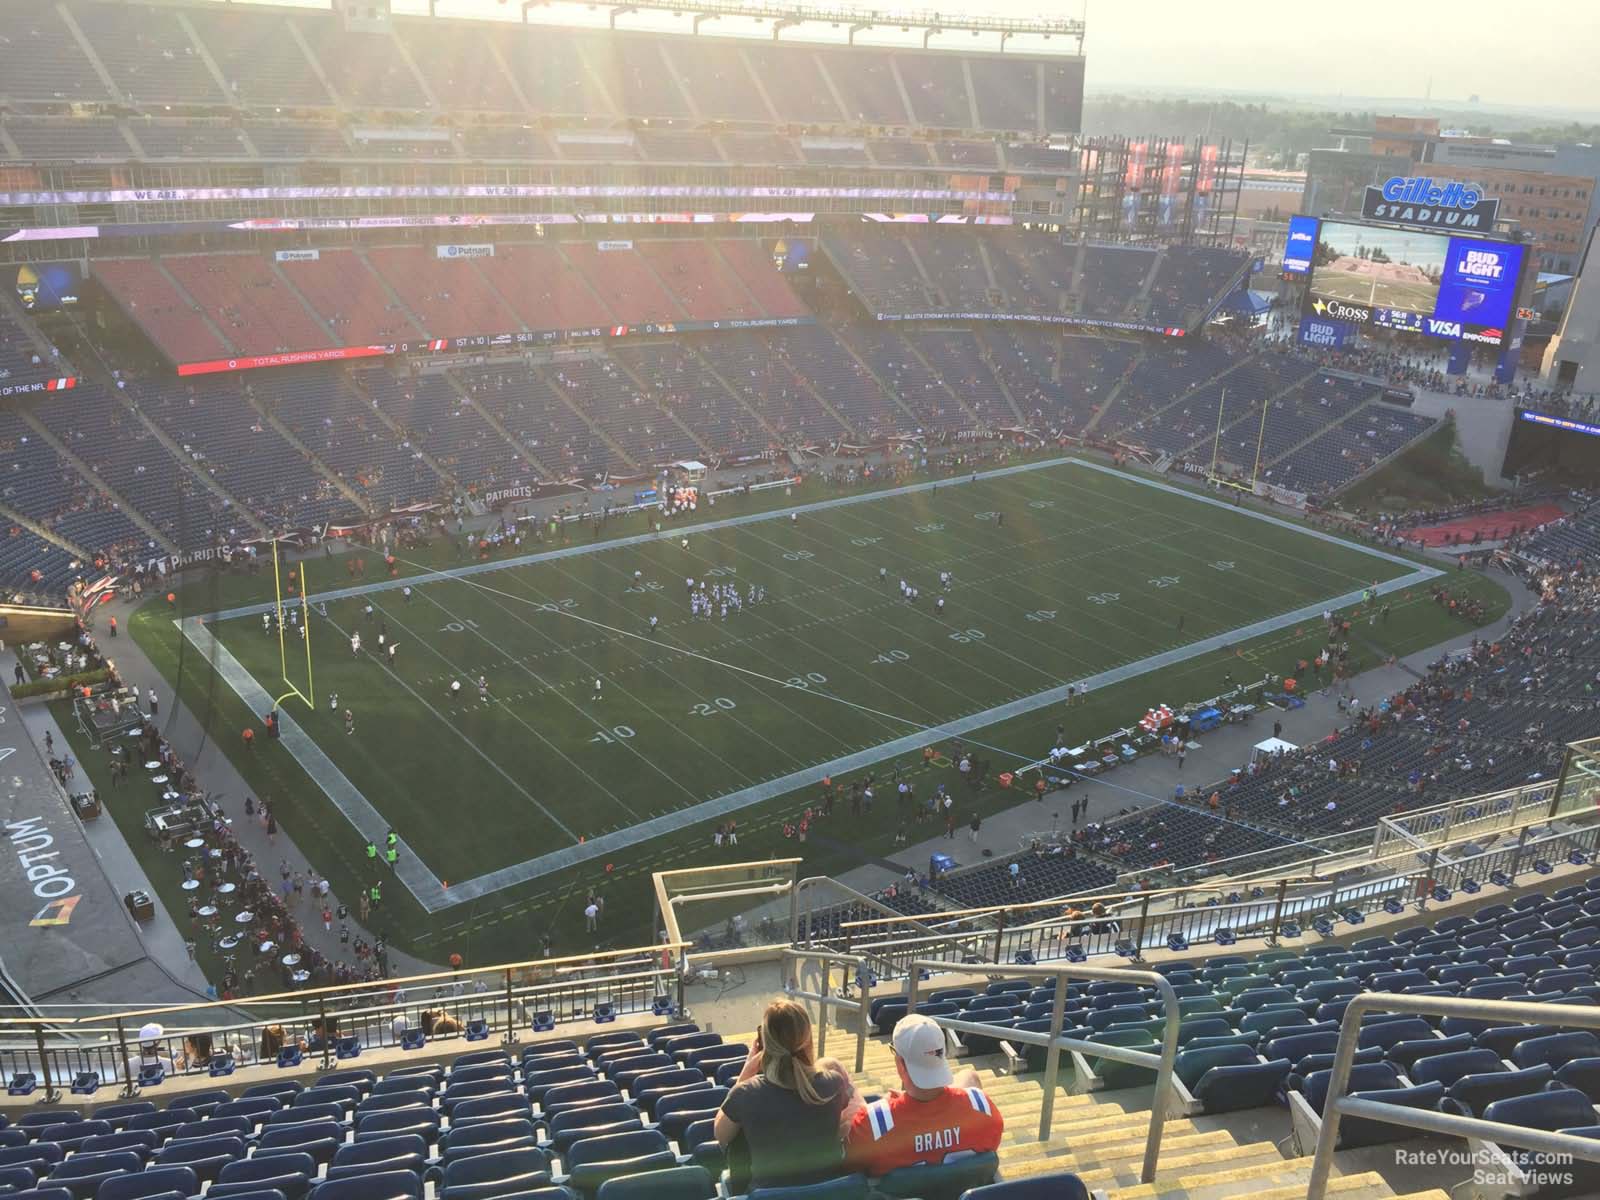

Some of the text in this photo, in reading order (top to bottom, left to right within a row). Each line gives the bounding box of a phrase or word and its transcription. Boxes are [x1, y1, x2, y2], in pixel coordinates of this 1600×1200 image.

[1382, 176, 1480, 210] Gillette
[1374, 204, 1481, 227] STADIUM
[459, 247, 490, 257] Putnam
[1467, 250, 1499, 265] BUD
[1458, 261, 1502, 278] LIGHT
[591, 328, 601, 337] 45
[1310, 323, 1334, 336] BUD
[1428, 319, 1461, 337] VISA
[1304, 332, 1336, 345] LIGHT
[1462, 332, 1502, 345] EMPOWER
[253, 357, 280, 366] TOTAL
[281, 353, 317, 363] RUSHING
[318, 350, 345, 360] YARDS
[2, 382, 46, 396] OF THE NFL
[486, 486, 532, 501] PATRIOTS
[949, 629, 986, 643] 50
[877, 649, 911, 664] 40
[785, 672, 828, 690] 30
[692, 697, 737, 717] 20
[594, 725, 637, 744] 10
[6, 815, 76, 898] OPTUM
[915, 1126, 960, 1153] BRADY
